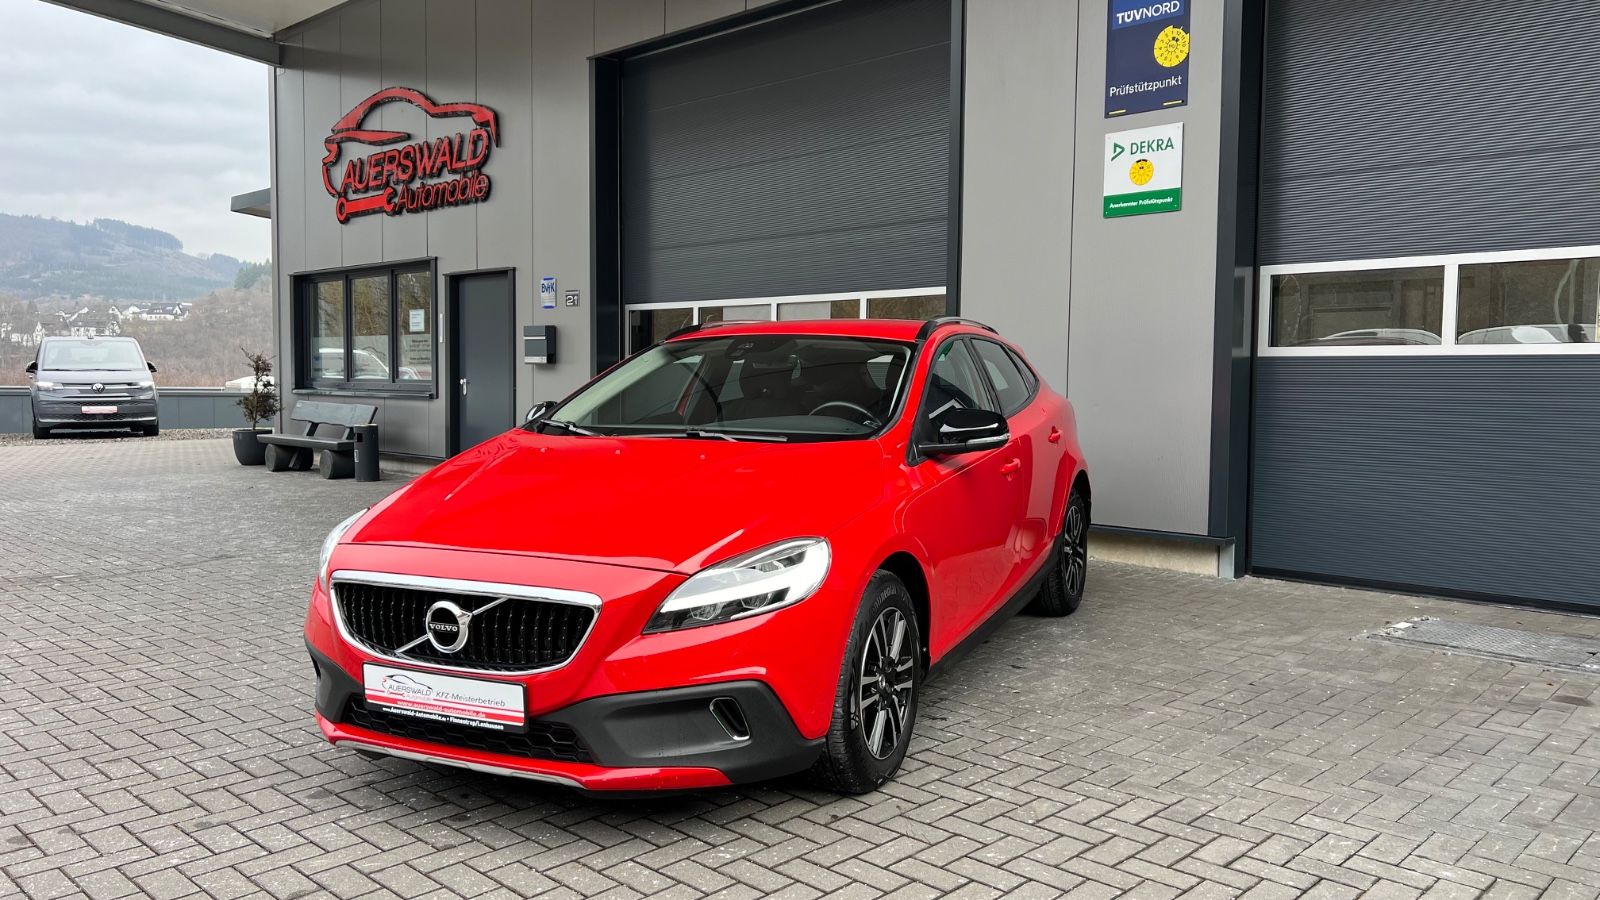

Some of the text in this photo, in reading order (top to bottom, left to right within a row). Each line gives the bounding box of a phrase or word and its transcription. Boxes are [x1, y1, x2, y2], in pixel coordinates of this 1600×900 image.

[1109, 75, 1182, 97] Prüfstützpunkt
[1130, 136, 1174, 155] DEKRA
[339, 128, 491, 195] AUERSWALD
[395, 171, 491, 213] Automobile
[566, 295, 578, 306] 21
[429, 623, 458, 632] VOLVO
[388, 684, 432, 697] AUERSWALD
[436, 691, 506, 707] KFZ-Meisterbetrieb
[396, 701, 486, 719] www.auerswald-automobile.de
